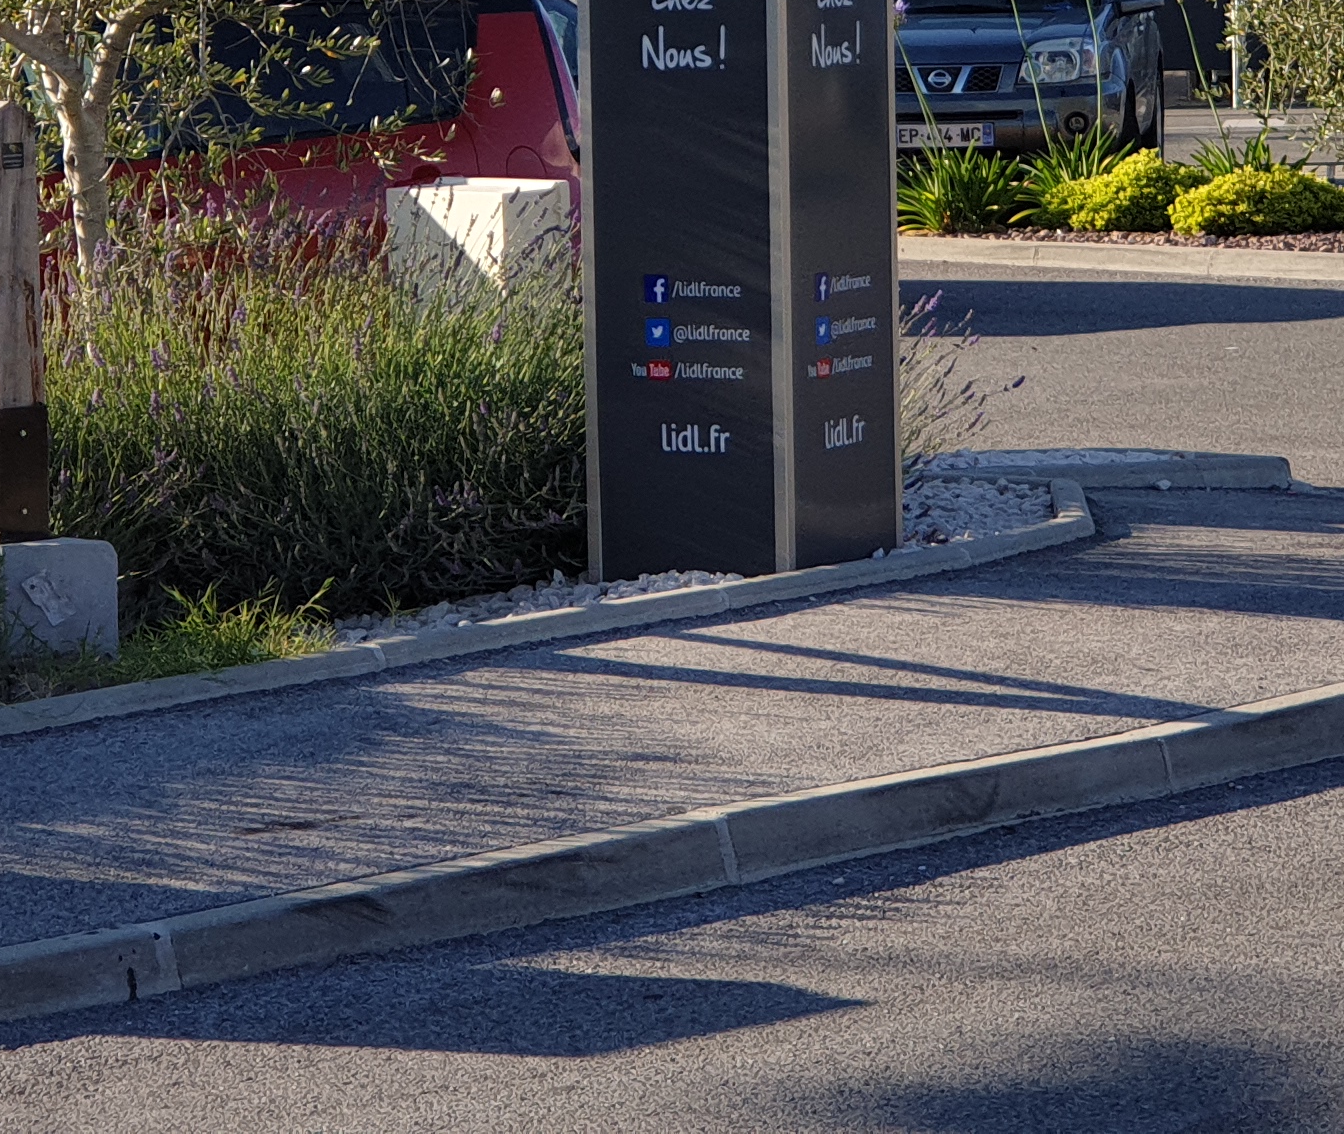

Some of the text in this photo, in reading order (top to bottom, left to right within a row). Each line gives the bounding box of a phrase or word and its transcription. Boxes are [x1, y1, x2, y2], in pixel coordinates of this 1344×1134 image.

[898, 127, 981, 144] EP-44-MC
[672, 281, 741, 299] /lidlfrance
[673, 324, 750, 343] @lidlfrance
[674, 362, 743, 380] /lidlfrance
[661, 423, 730, 454] lidl.fr
[824, 414, 866, 449] lidl.fr
